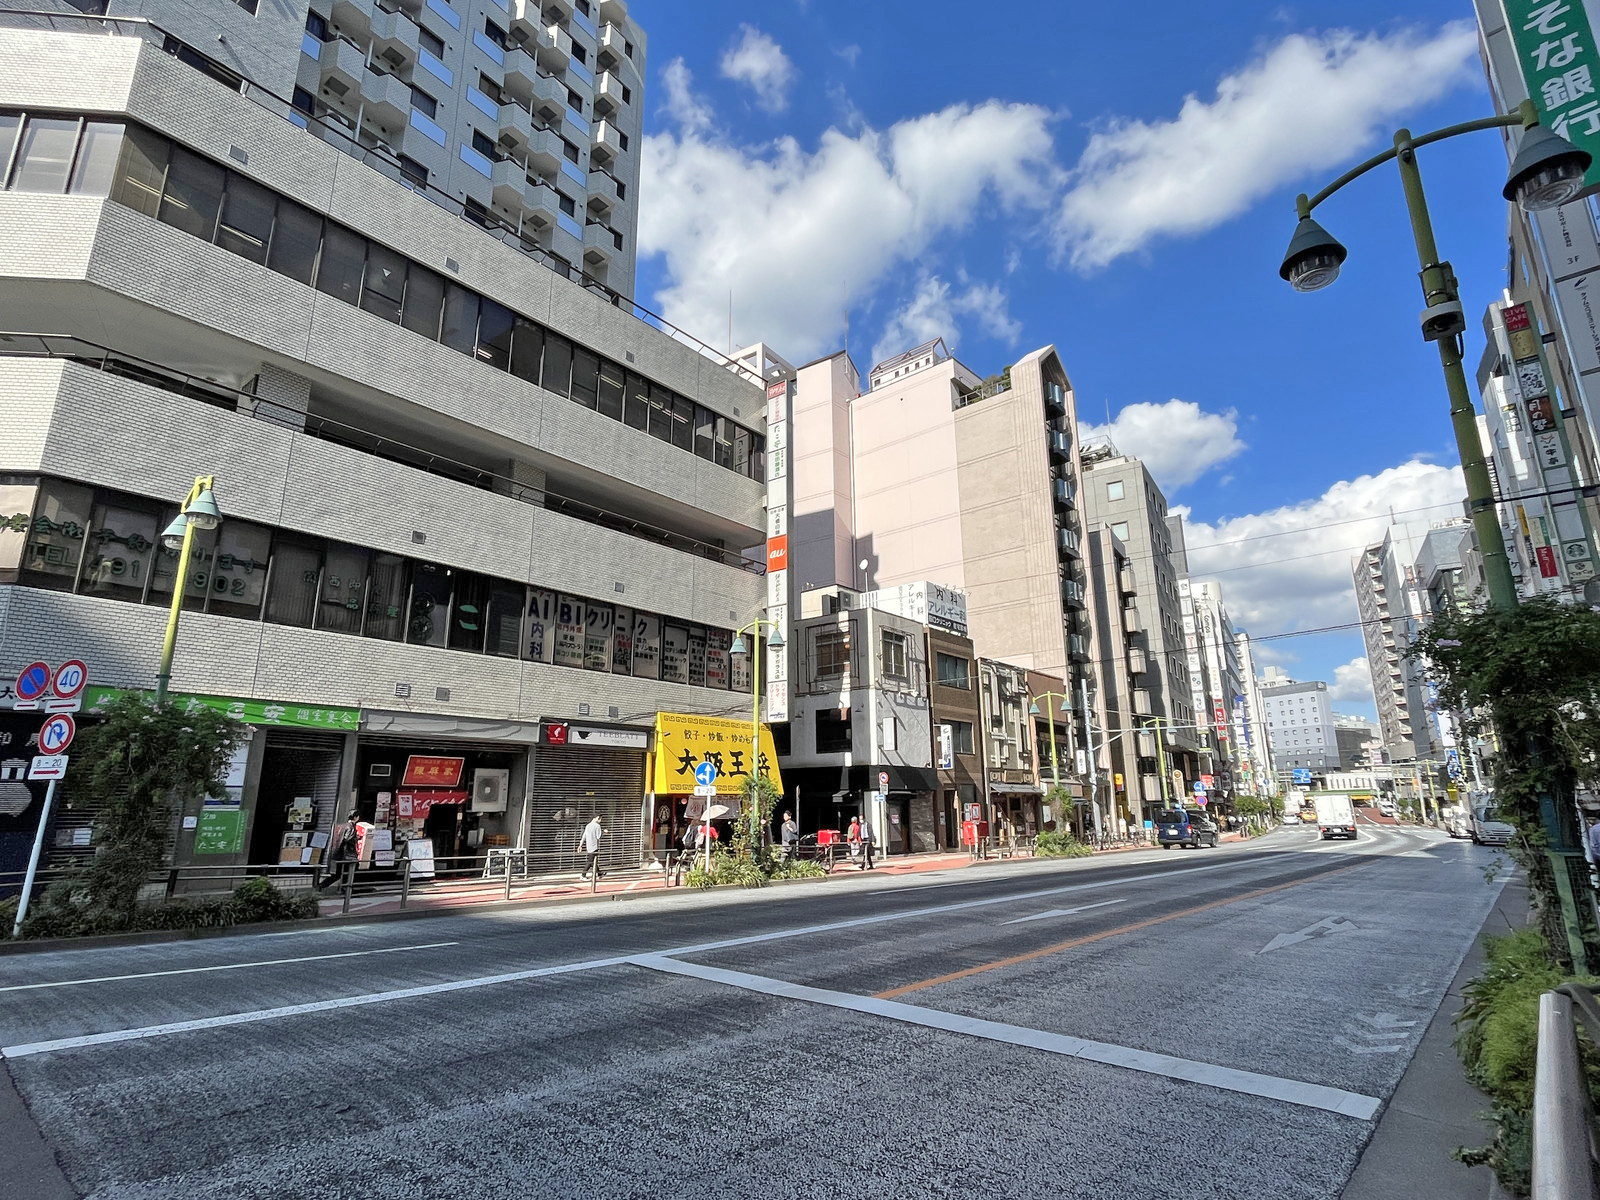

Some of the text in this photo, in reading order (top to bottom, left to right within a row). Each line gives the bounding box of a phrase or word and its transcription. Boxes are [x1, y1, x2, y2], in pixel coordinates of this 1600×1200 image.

[1567, 254, 1579, 265] 3F
[1499, 508, 1520, 569] カラオケ
[770, 549, 786, 559] au
[916, 592, 923, 615] 内科
[936, 586, 958, 606] 内科
[928, 600, 966, 623] アレルギー科
[530, 621, 544, 659] 内科
[59, 670, 80, 687] 40
[675, 748, 771, 778] 大阪王将
